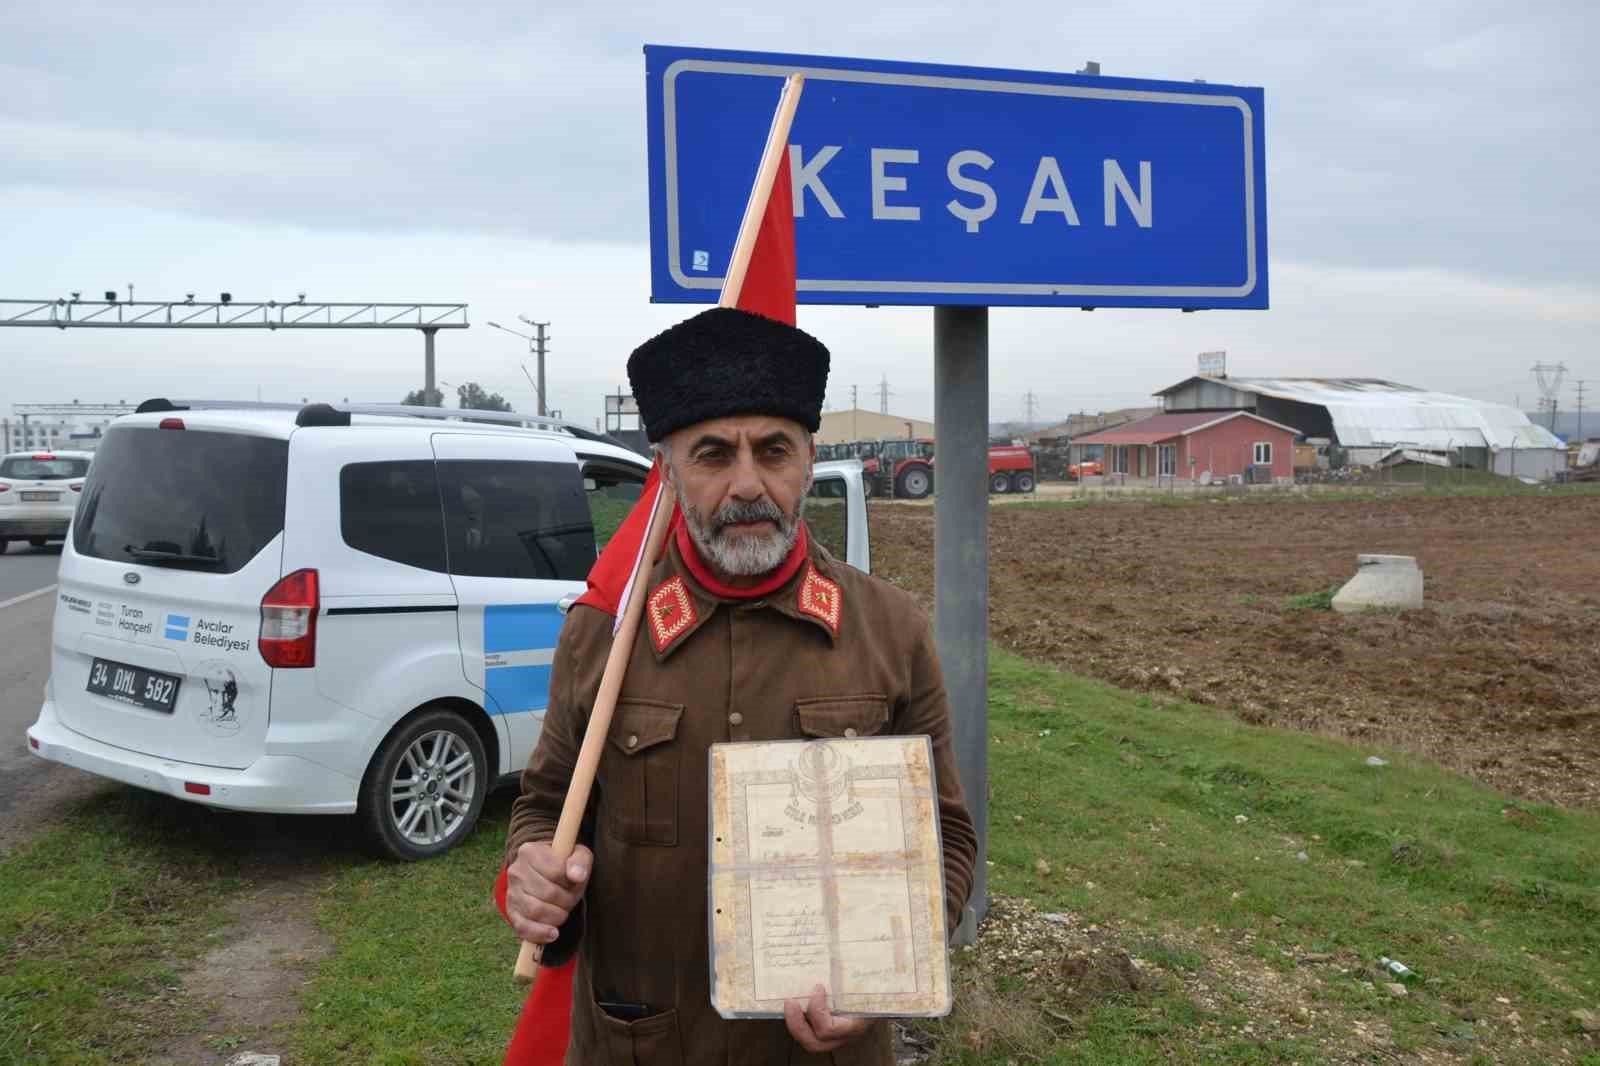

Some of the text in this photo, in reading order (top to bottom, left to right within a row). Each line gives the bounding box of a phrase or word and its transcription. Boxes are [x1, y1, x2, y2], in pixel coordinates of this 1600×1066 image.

[788, 144, 1153, 232] KEŞAN
[121, 605, 143, 618] Turan
[197, 619, 234, 633] Avcılar
[193, 632, 250, 651] Belediyesi
[92, 663, 108, 686] 34
[144, 676, 173, 705] 582
